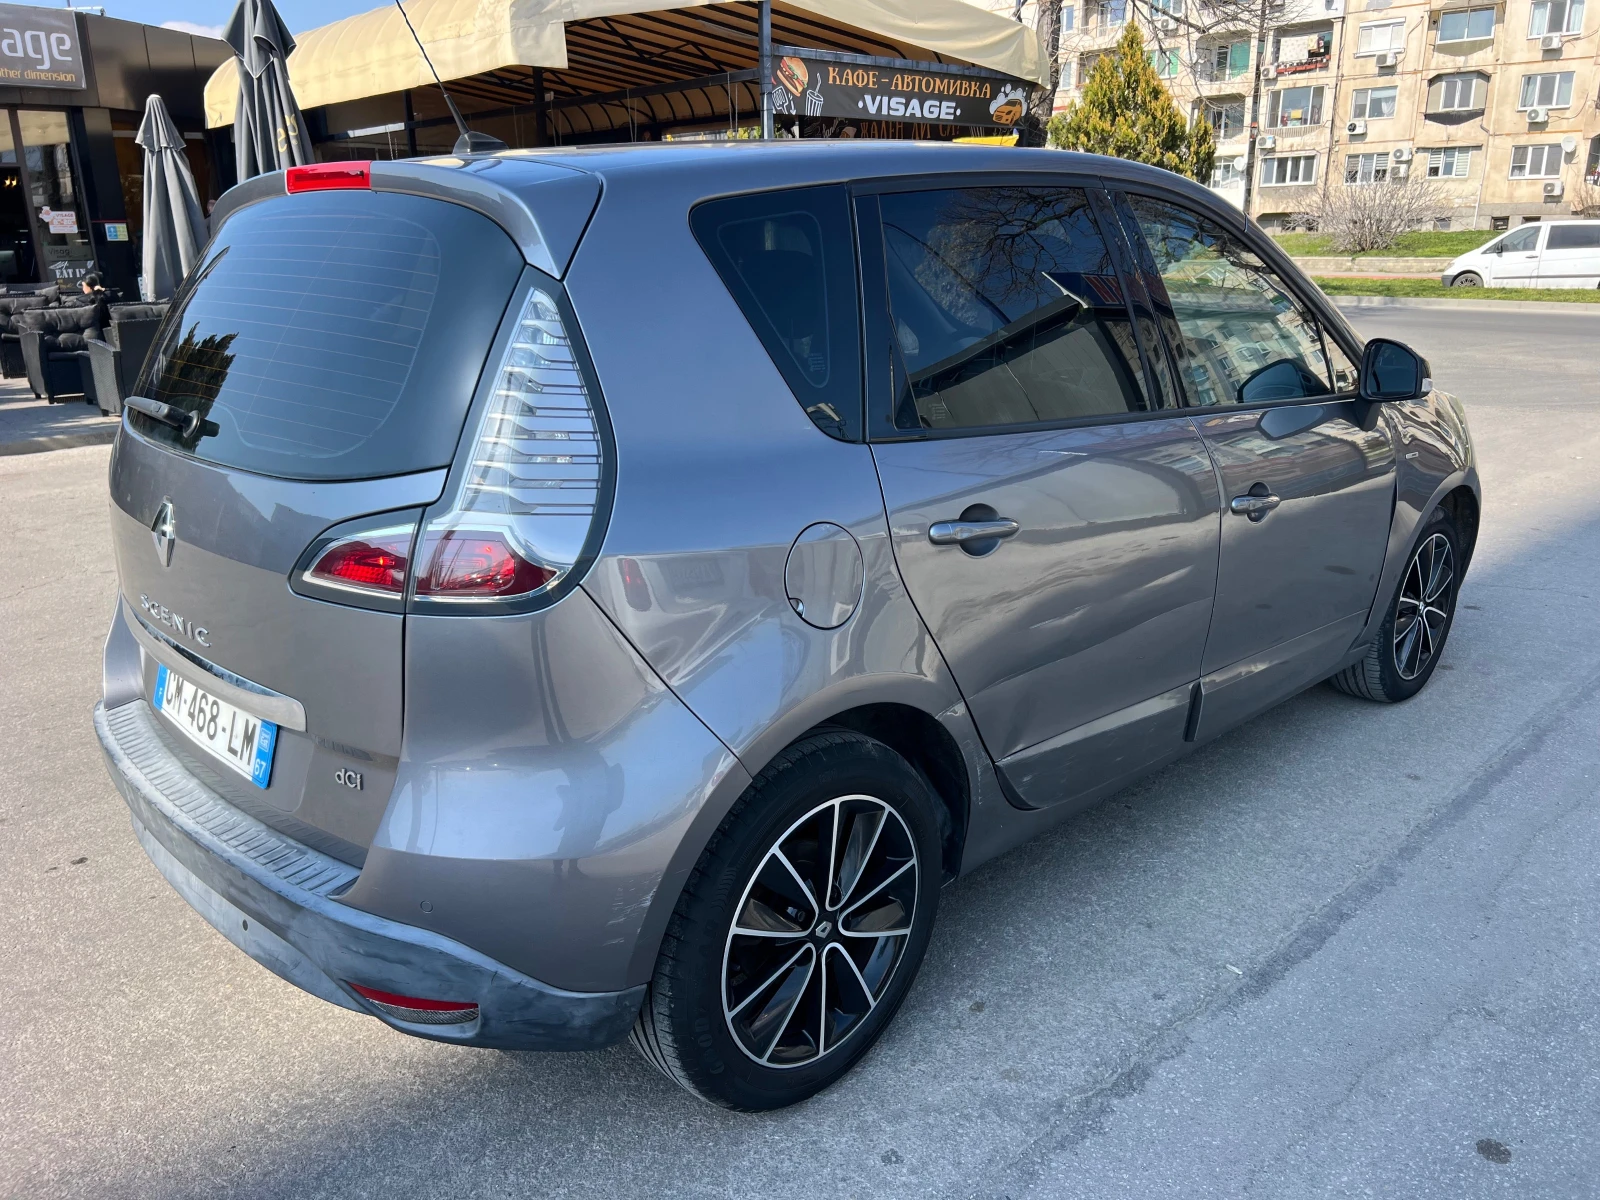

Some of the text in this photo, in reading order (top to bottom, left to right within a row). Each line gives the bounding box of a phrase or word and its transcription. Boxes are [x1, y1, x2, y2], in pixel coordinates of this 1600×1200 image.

[1, 28, 73, 70] age
[0, 67, 76, 82] ther dimension
[827, 66, 879, 89] КАФЕ
[890, 73, 992, 99] АВТОМИВКА
[863, 94, 957, 120] VISAGE
[55, 268, 74, 279] EAT
[140, 593, 212, 648] SCENIC
[254, 758, 267, 779] 67
